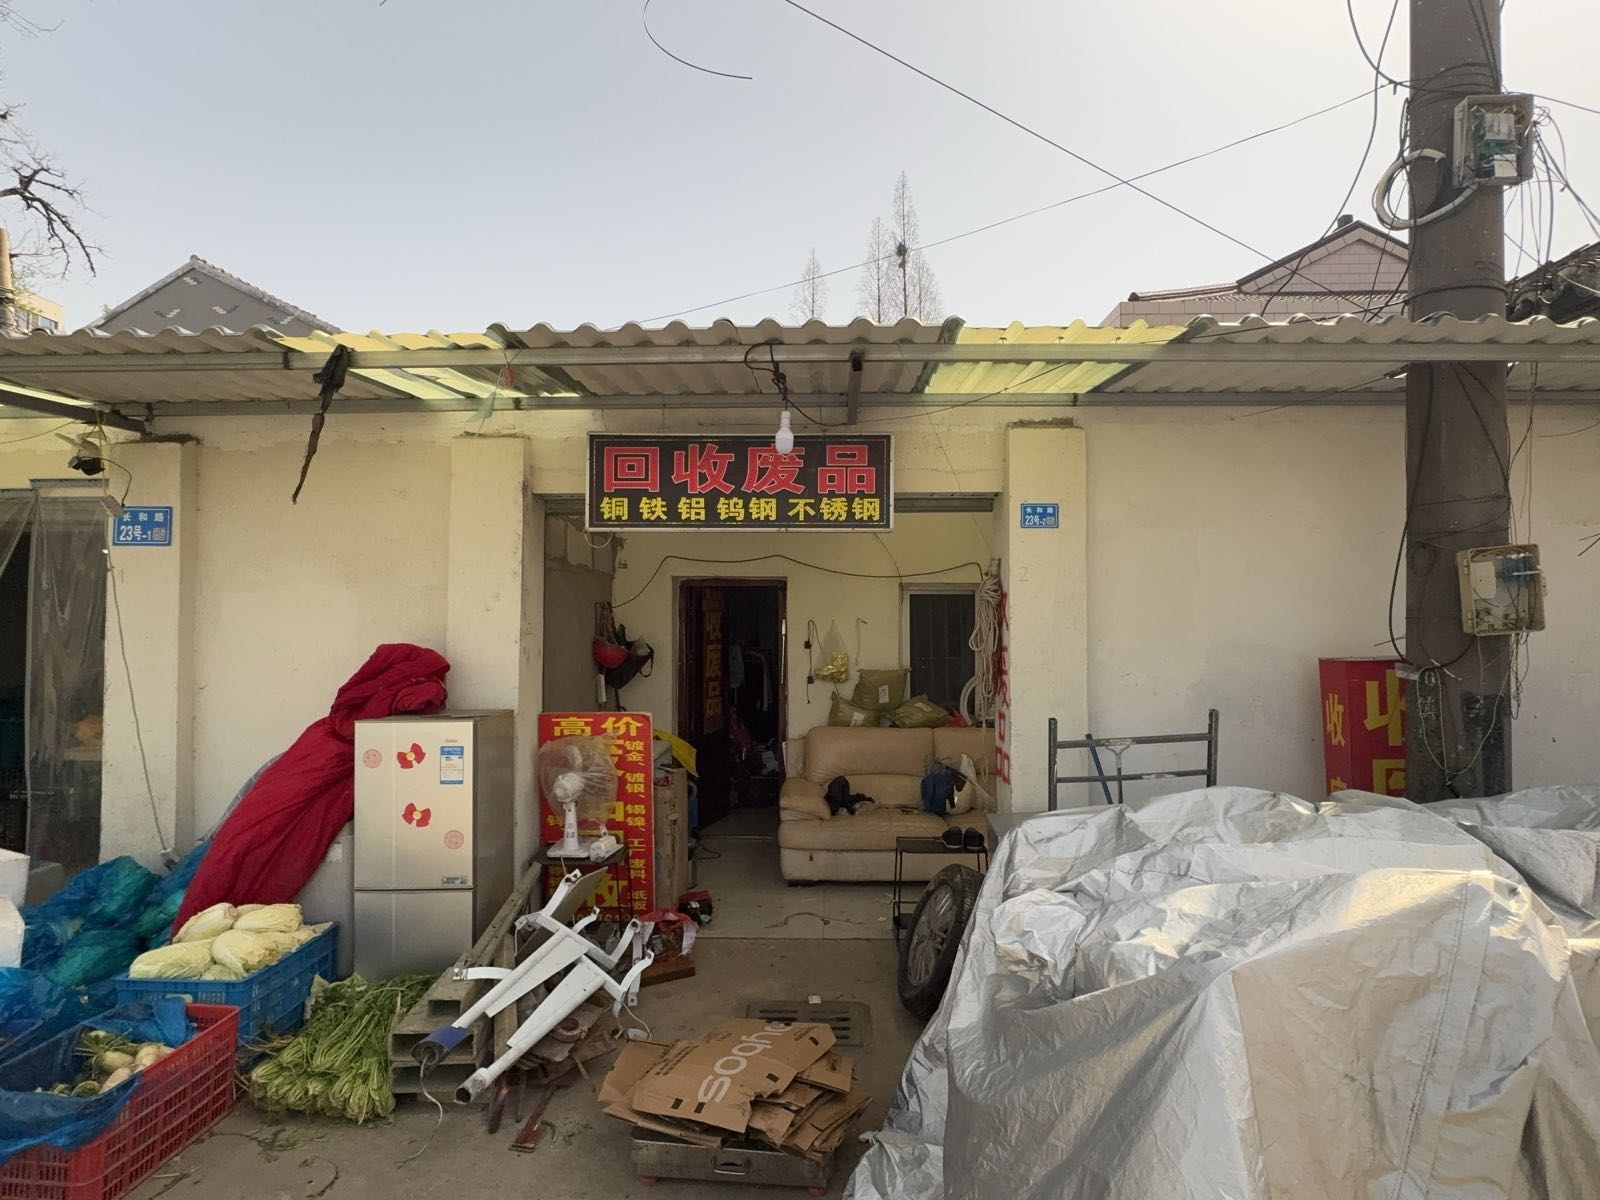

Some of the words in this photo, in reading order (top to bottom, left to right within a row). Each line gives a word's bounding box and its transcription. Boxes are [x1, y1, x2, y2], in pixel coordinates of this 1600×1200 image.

[603, 443, 876, 495] 回收废品
[600, 497, 628, 521] 铜
[639, 497, 667, 521] 铁
[677, 497, 705, 521] 铝
[716, 497, 777, 521] 钨钢
[787, 497, 880, 521] 不锈钢
[551, 716, 644, 737] 高价
